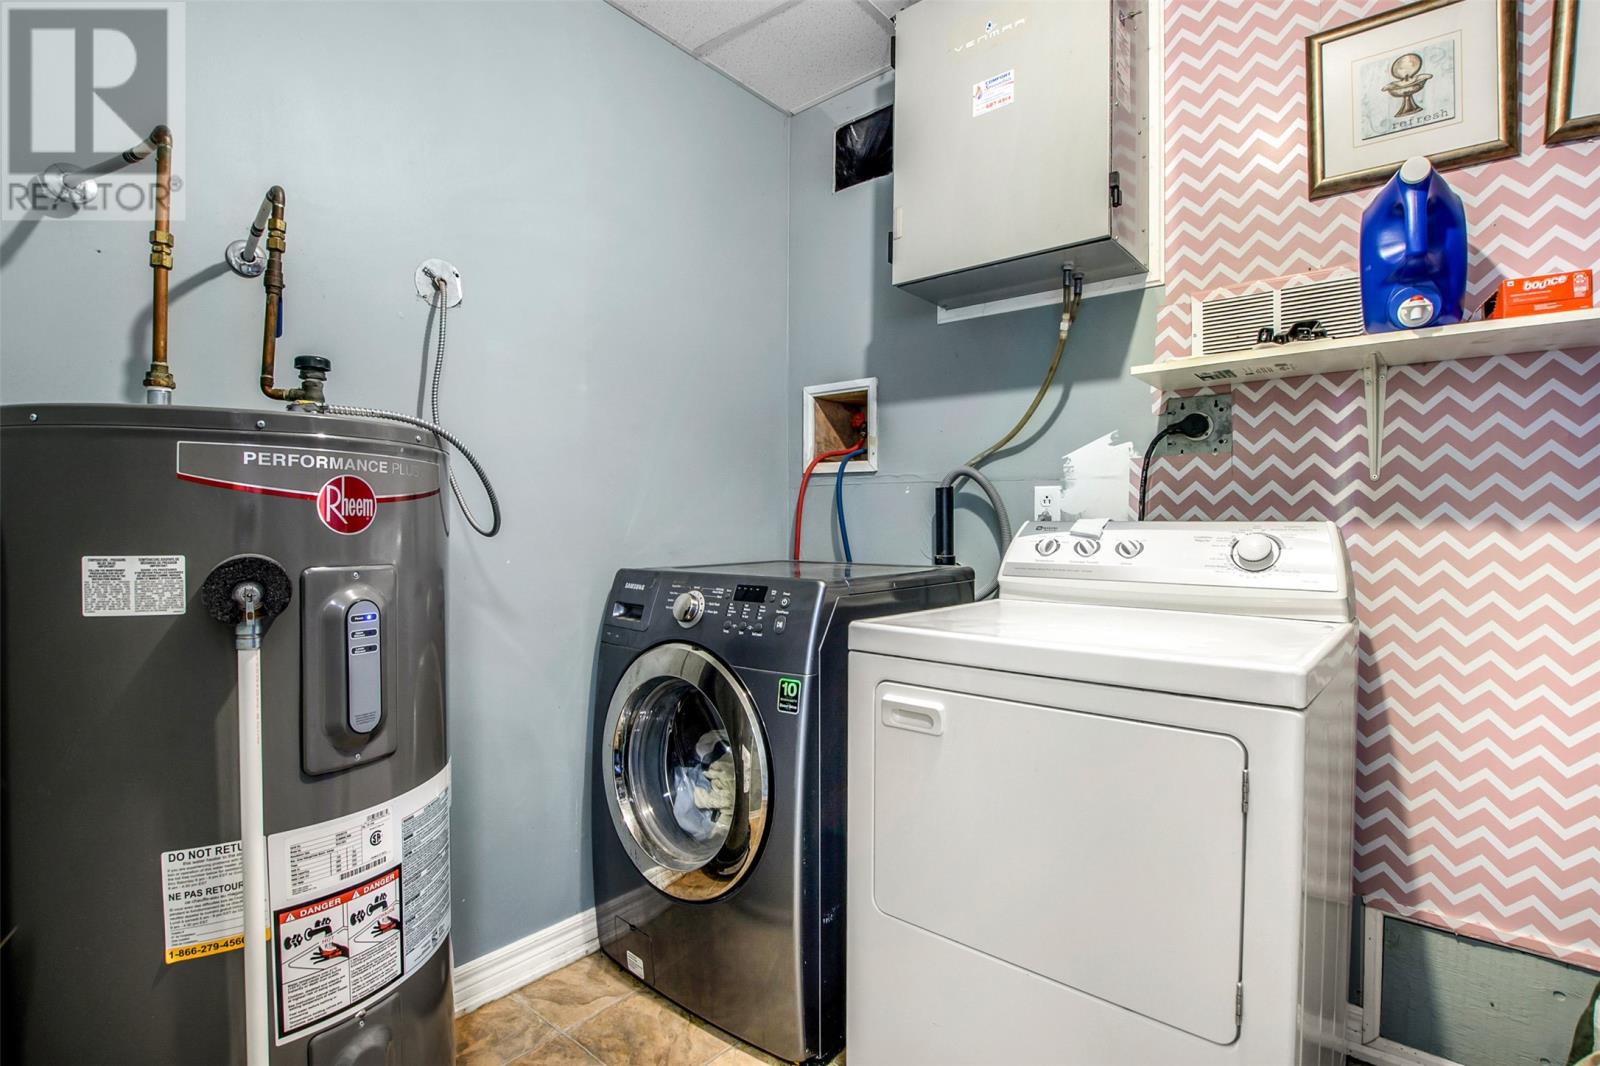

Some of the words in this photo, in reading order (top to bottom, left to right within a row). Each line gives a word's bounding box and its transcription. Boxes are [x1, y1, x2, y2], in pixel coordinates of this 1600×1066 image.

[1391, 108, 1449, 130] refresh
[1523, 275, 1567, 291] bounce
[243, 451, 388, 473] PERFORMANCE
[326, 476, 373, 525] Rheem
[624, 582, 646, 592] SAMSUNG
[781, 682, 798, 697] 10
[168, 852, 185, 863] DO
[188, 848, 212, 860] NOT
[363, 873, 396, 894] DANGER
[168, 892, 182, 902] NE
[184, 889, 203, 899] PAS
[299, 897, 342, 918] DANGER
